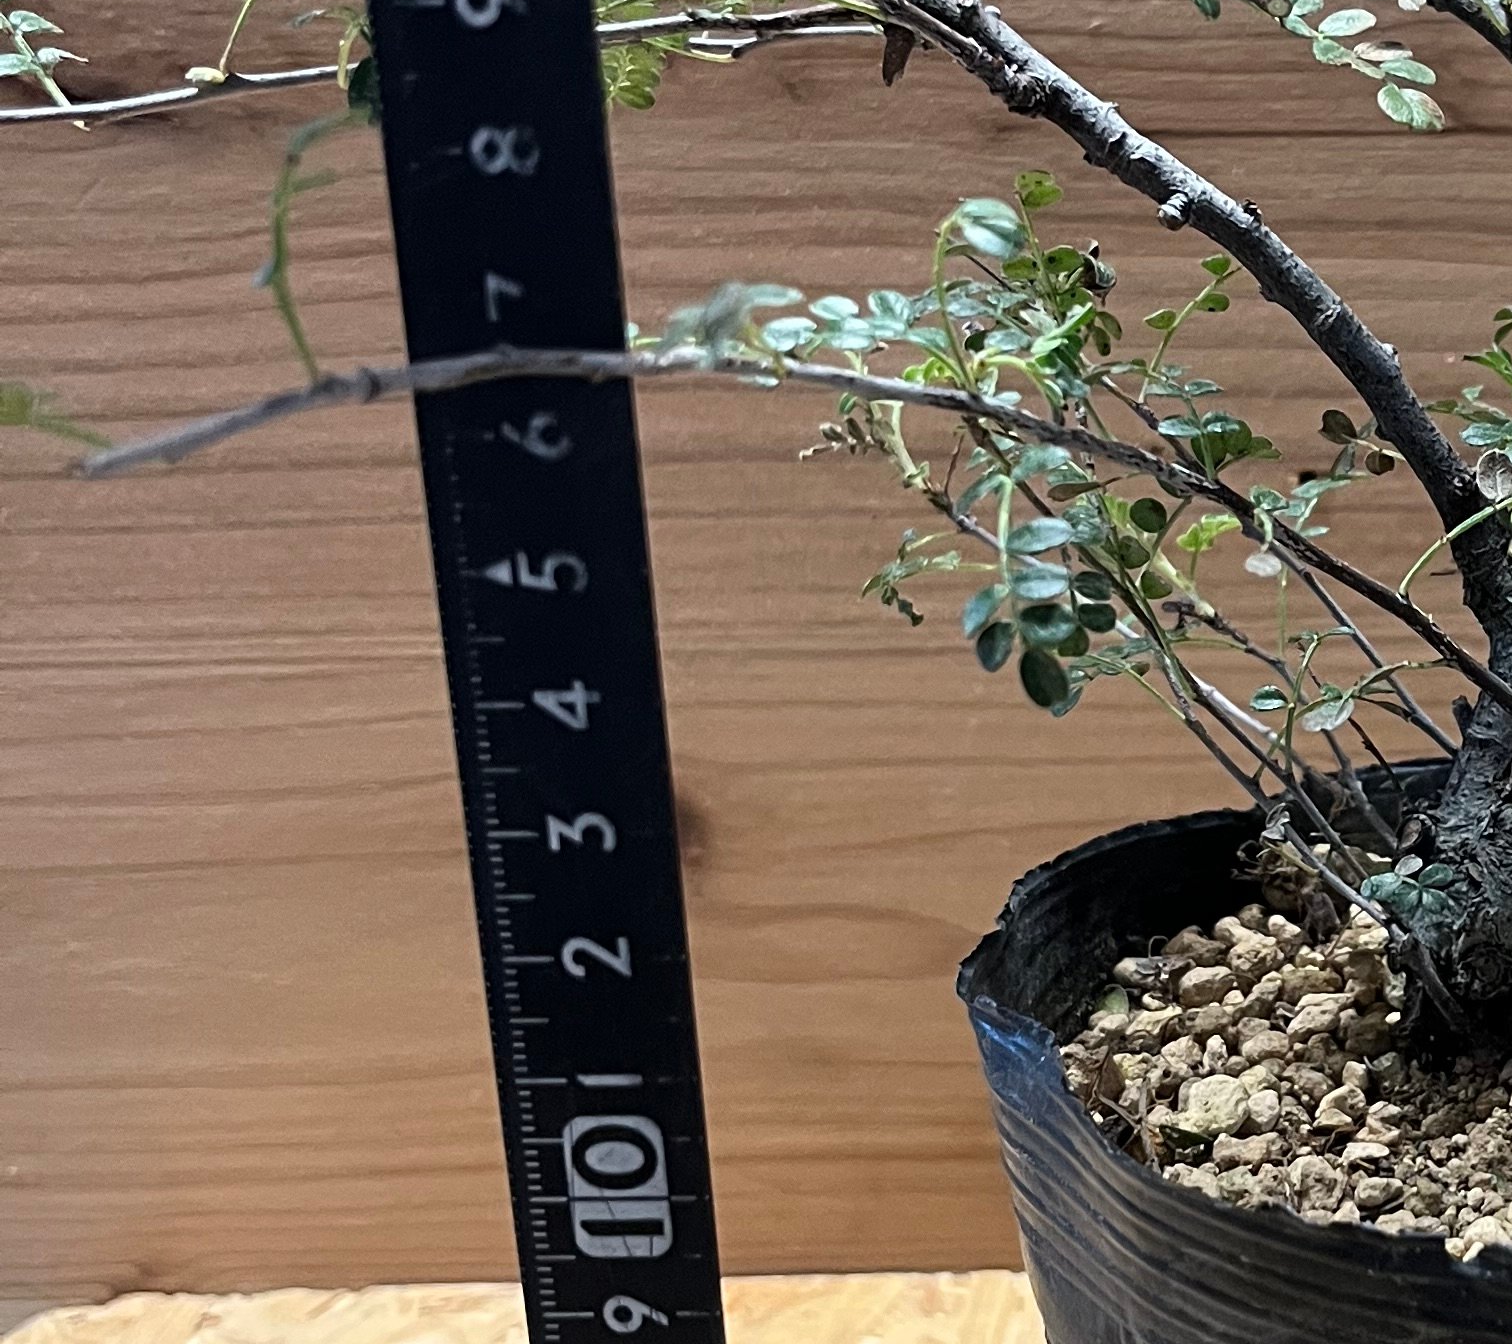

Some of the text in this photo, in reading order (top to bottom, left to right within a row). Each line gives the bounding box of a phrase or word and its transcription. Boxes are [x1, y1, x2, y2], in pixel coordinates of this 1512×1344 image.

[471, 127, 538, 173] 8
[517, 552, 586, 590] 5
[534, 681, 598, 728] 4
[547, 813, 615, 851] 3
[562, 938, 631, 976] 2
[572, 1126, 665, 1237] 10
[603, 1296, 668, 1332] 9
